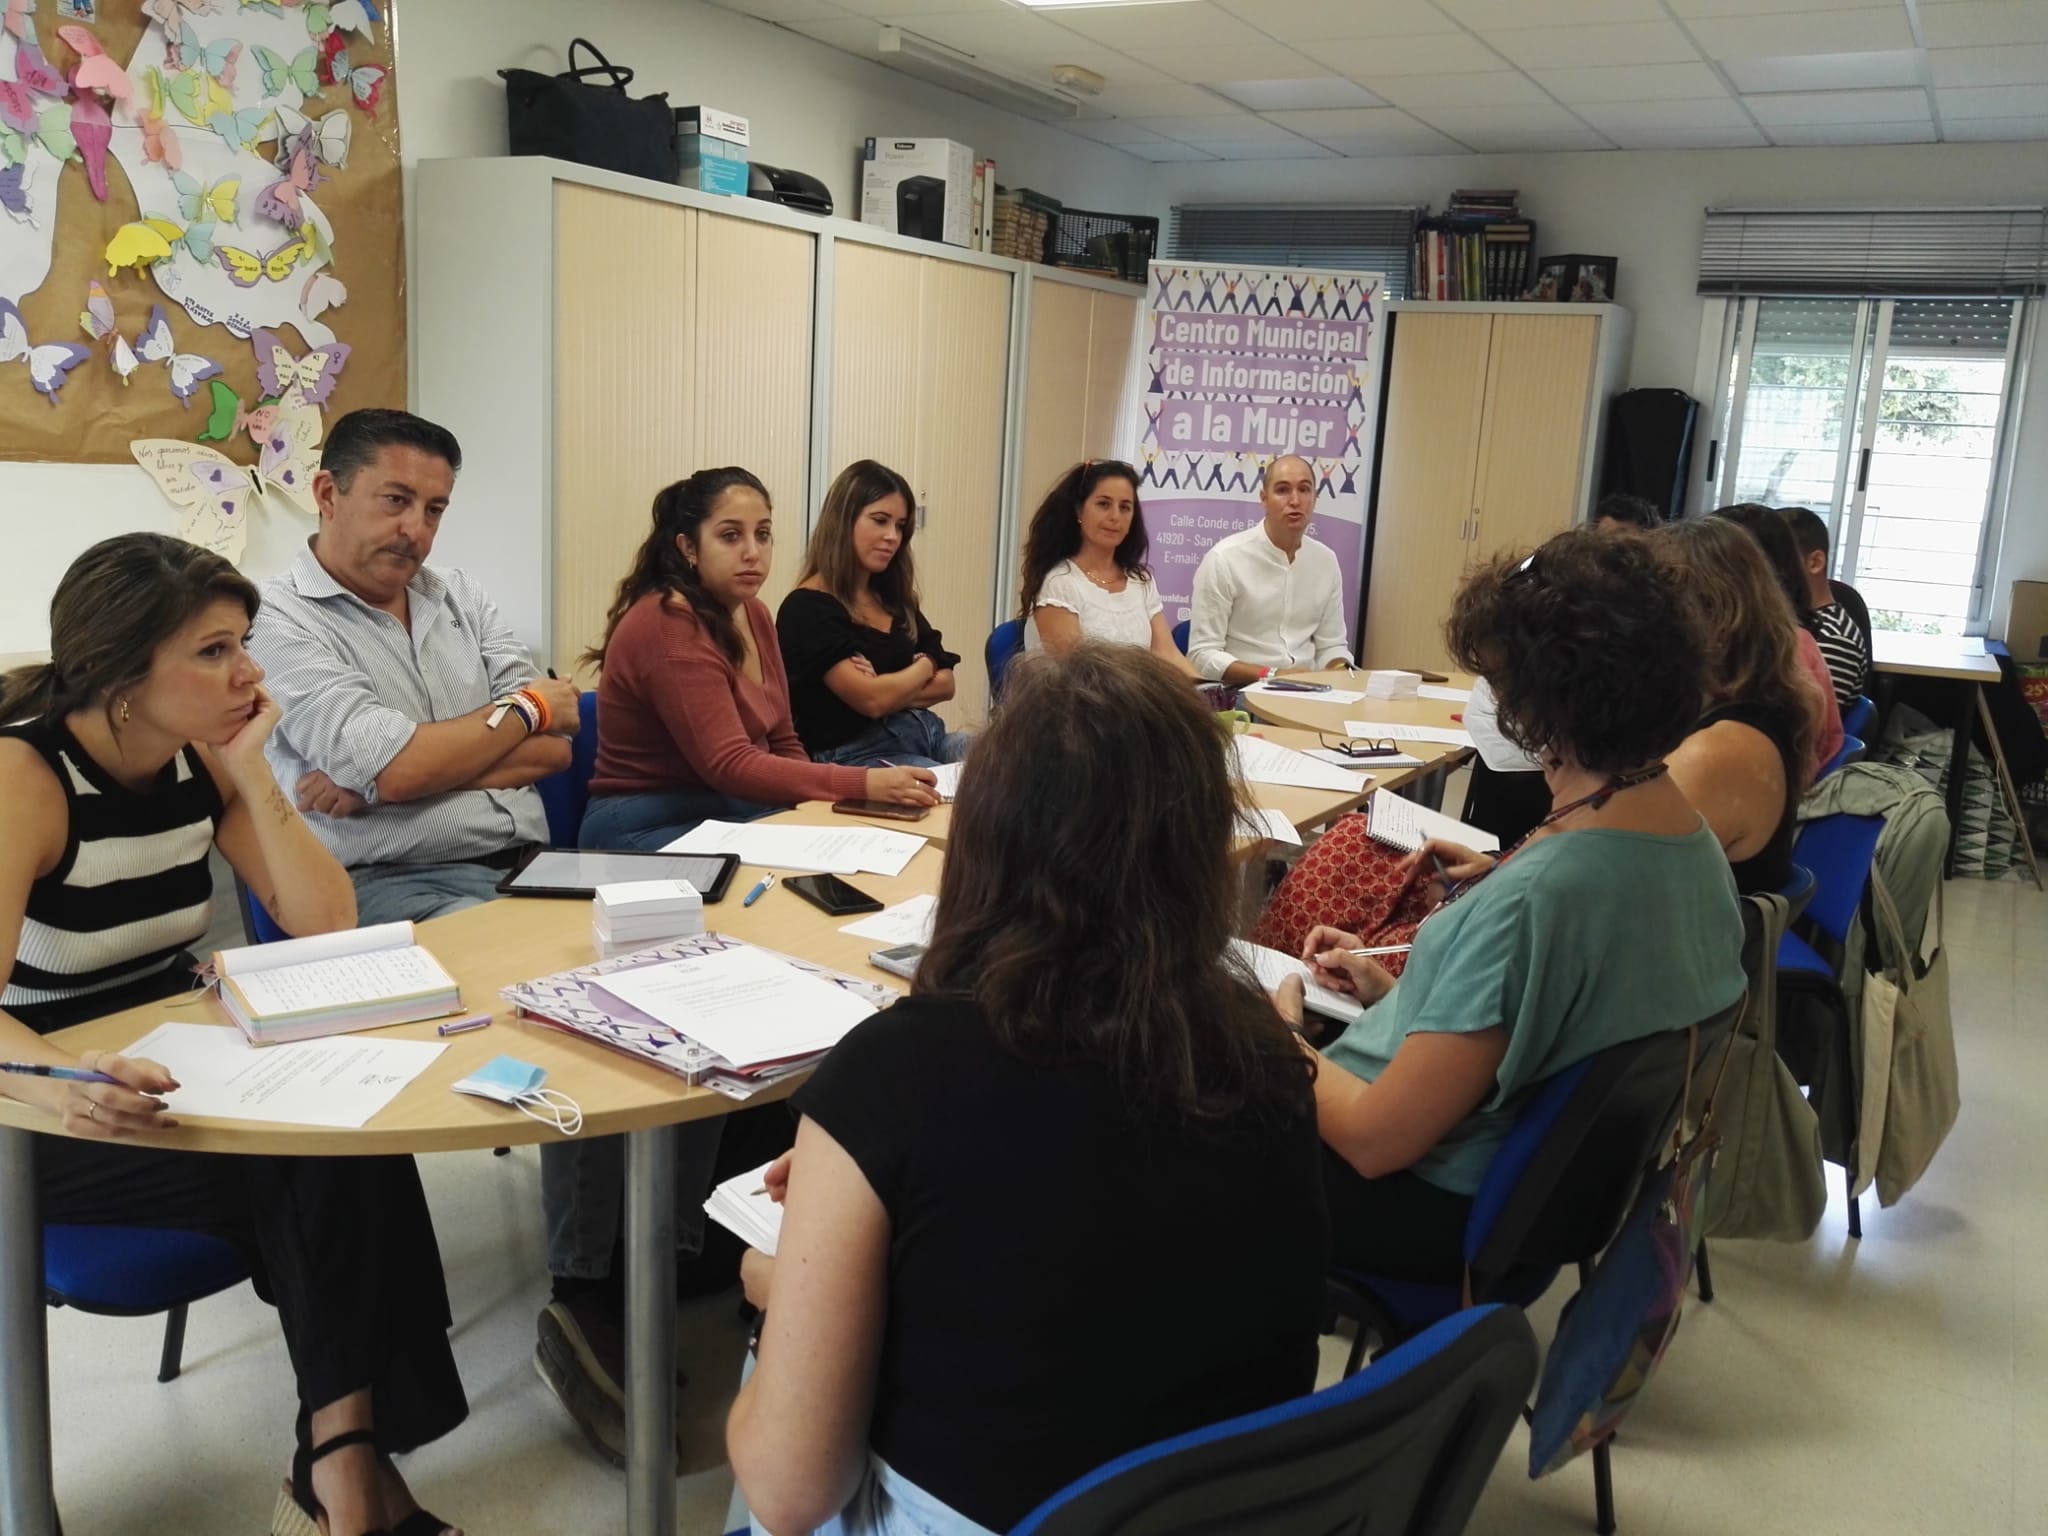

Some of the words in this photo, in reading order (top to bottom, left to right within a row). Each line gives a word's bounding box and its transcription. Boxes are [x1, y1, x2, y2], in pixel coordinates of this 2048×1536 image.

[1160, 314, 1240, 346] Centro
[1246, 319, 1363, 359] Municipal
[1165, 358, 1195, 386] de
[1201, 359, 1349, 395] Información
[1172, 411, 1193, 441] a
[1202, 404, 1232, 443] la
[1241, 406, 1335, 455] Mujer
[1170, 514, 1195, 528] Calle
[1197, 516, 1229, 530] Conde
[1231, 518, 1245, 530] de
[1156, 532, 1184, 545] 41920
[1194, 535, 1213, 547] San
[1164, 551, 1200, 565] E-mail:
